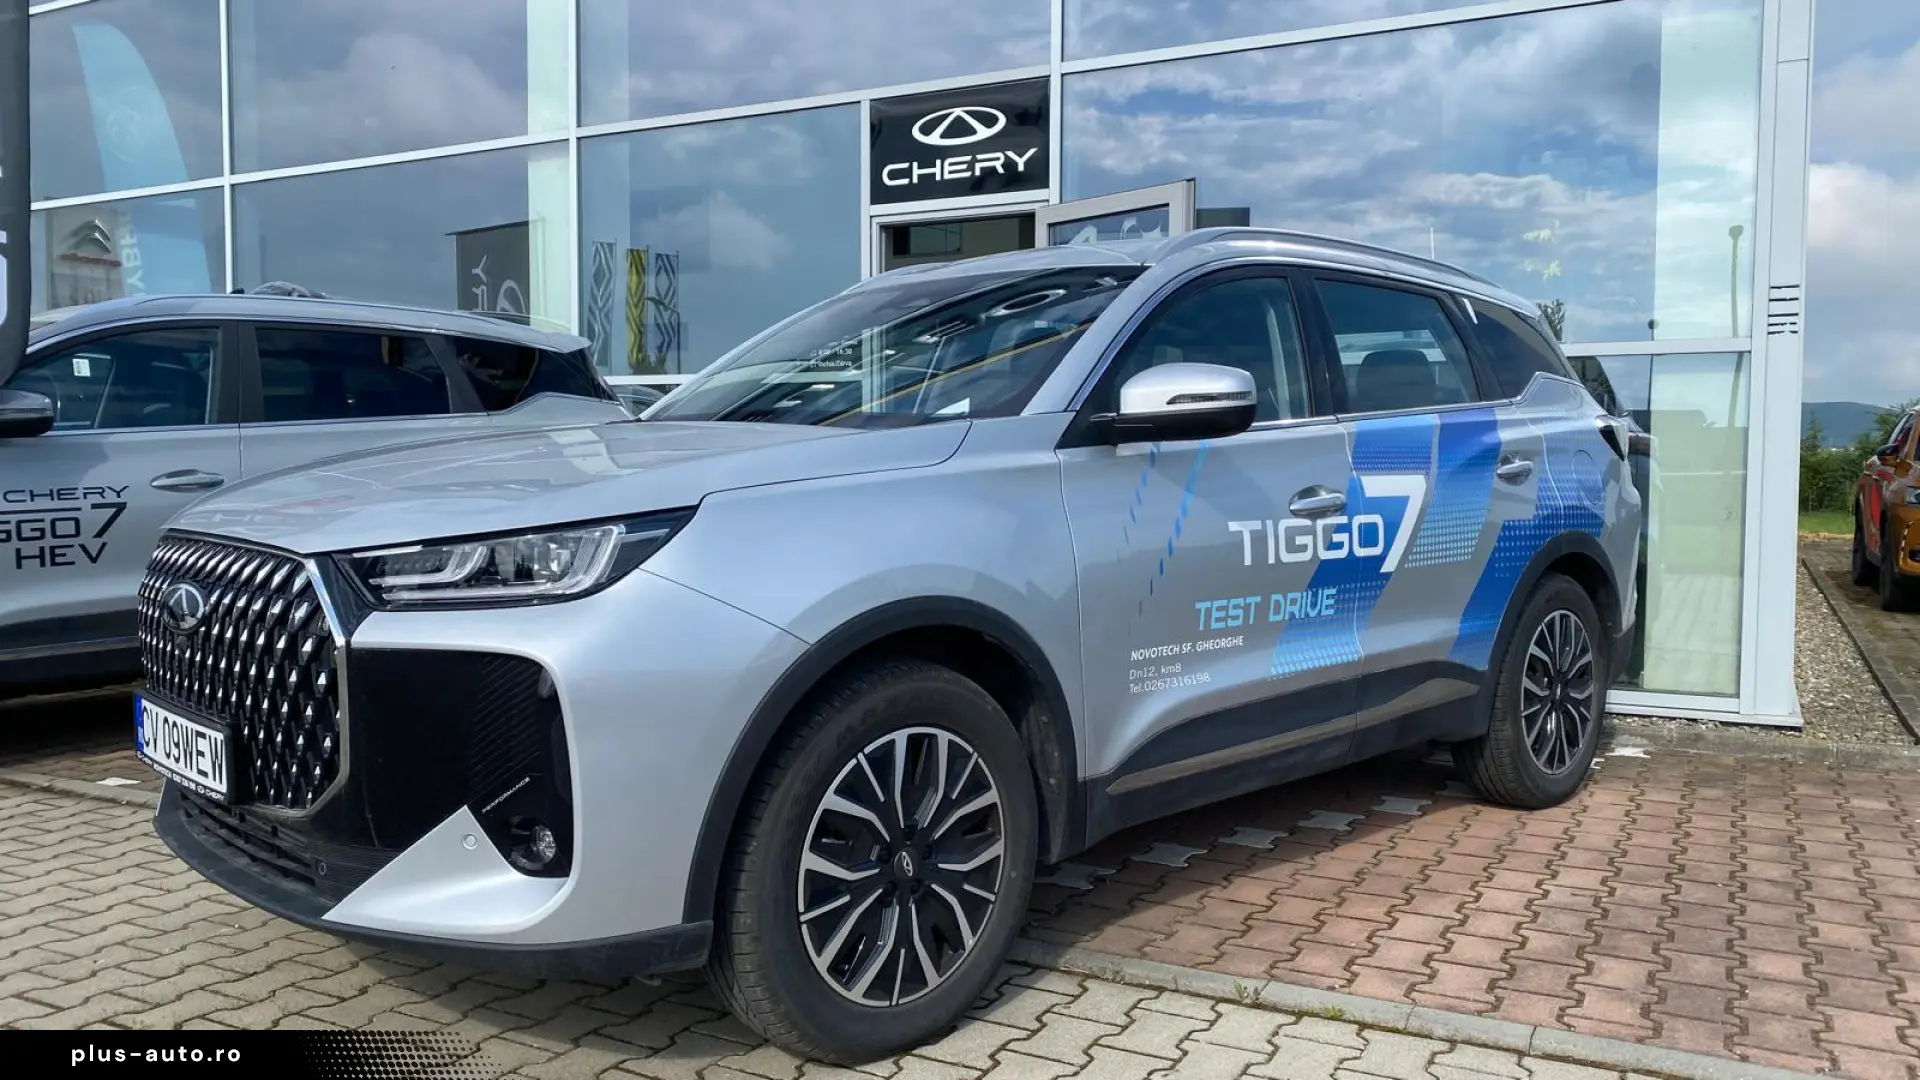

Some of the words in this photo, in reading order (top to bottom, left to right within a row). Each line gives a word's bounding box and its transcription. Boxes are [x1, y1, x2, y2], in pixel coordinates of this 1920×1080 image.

[882, 148, 1038, 187] CHERY
[3, 485, 130, 503] CHERY
[90, 502, 128, 539] 7
[1228, 514, 1386, 567] TIGGO
[1360, 474, 1428, 574] 7
[15, 541, 108, 570] HEV
[1195, 596, 1262, 632] TEST
[1268, 587, 1339, 623] DRIVE
[1131, 644, 1180, 662] NOVOTECH
[1182, 642, 1195, 654] SF.
[1196, 635, 1244, 652] GHEORGHE
[1161, 662, 1182, 675] km8
